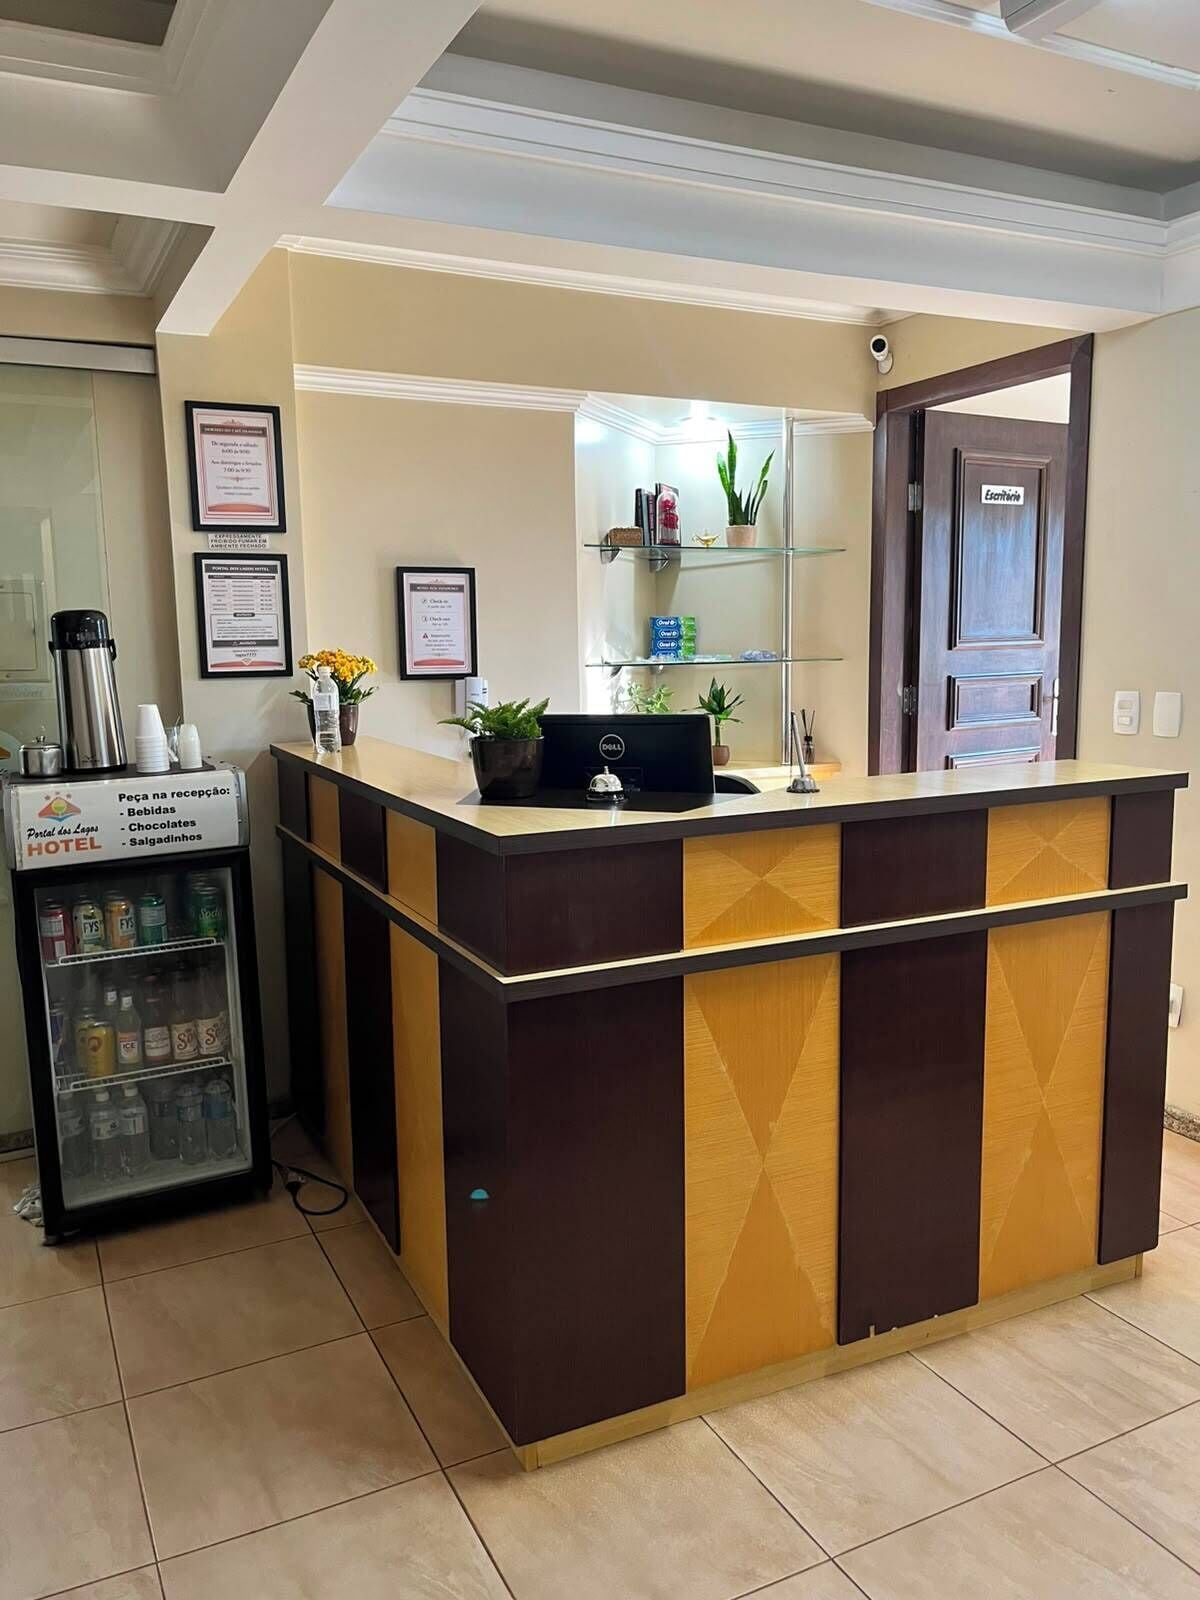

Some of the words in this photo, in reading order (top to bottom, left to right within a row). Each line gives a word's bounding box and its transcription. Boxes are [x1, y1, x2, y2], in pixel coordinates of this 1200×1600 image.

[984, 488, 1021, 502] Escritório
[118, 792, 149, 804] Peça
[152, 792, 166, 800] na
[170, 786, 230, 800] recepção:
[128, 804, 176, 817] Bebidas
[26, 826, 56, 840] Portal
[58, 826, 72, 836] dos
[73, 824, 99, 835] Lagos
[128, 818, 196, 832] Chocolates
[27, 836, 102, 856] HOTEL
[129, 832, 202, 848] Salgadinhos
